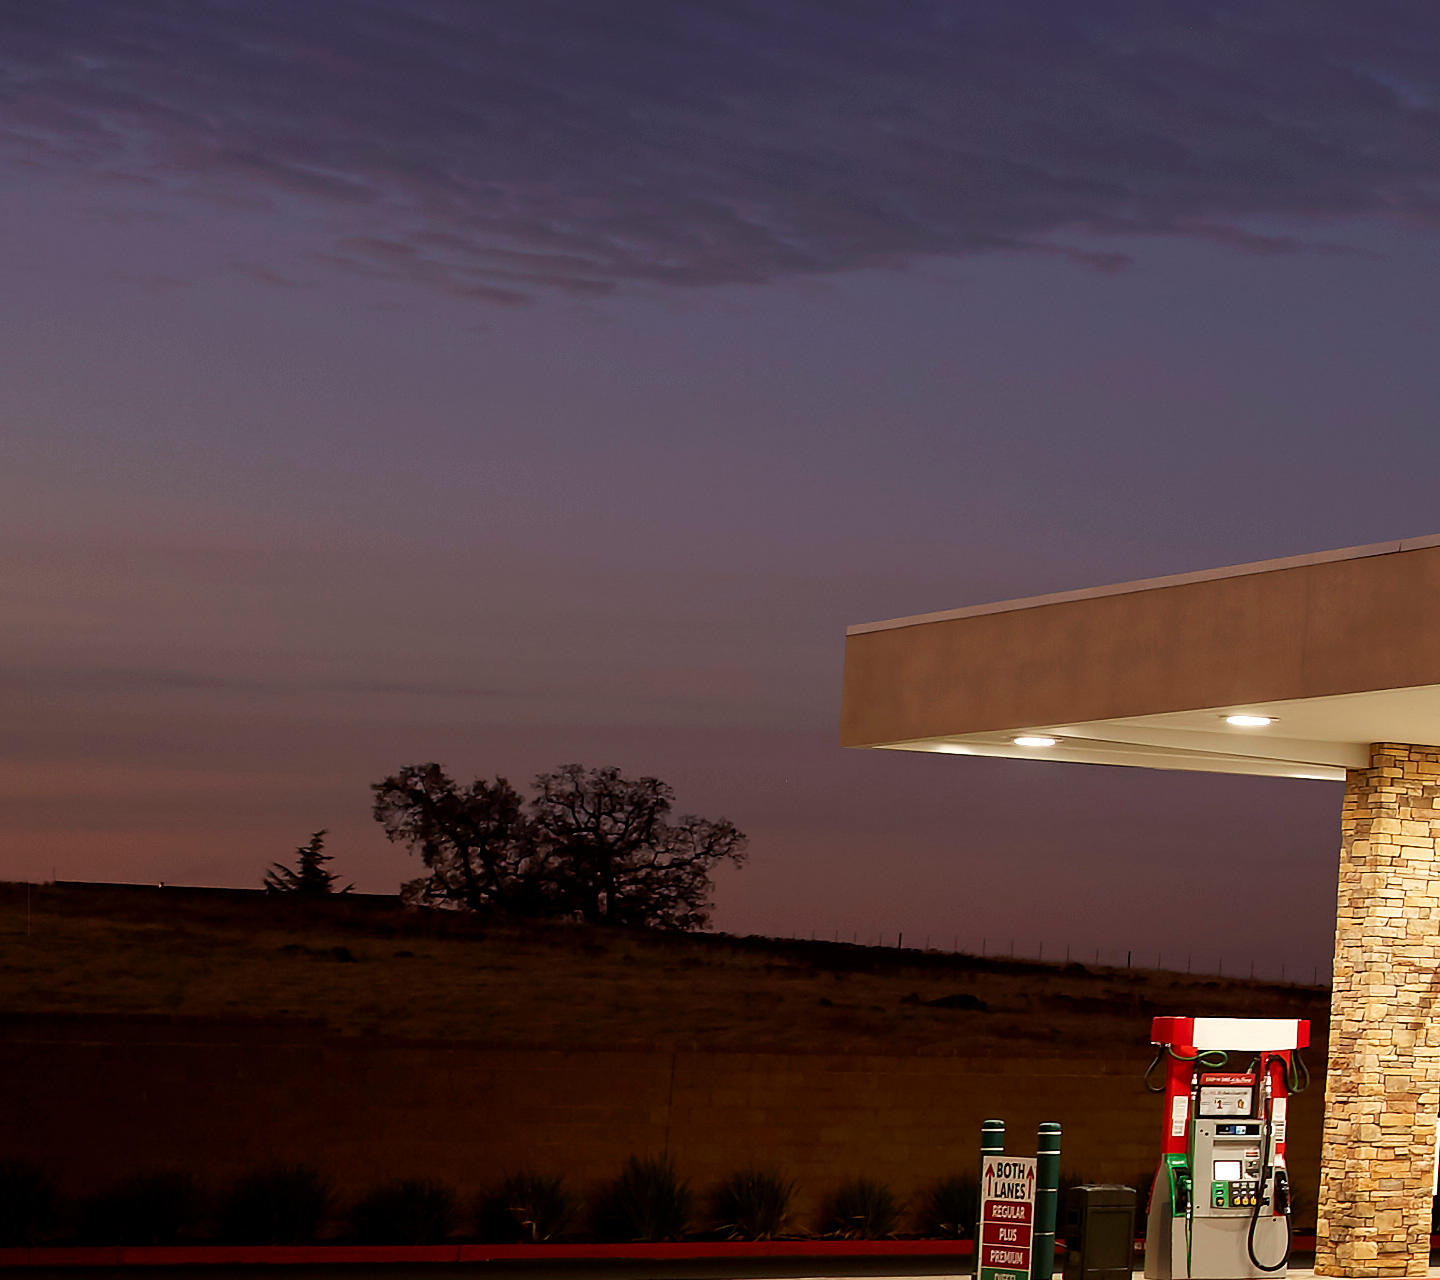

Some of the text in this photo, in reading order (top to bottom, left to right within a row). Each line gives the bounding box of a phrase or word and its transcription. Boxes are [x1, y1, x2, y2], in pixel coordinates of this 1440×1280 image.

[997, 1162, 1025, 1179] BOTH
[994, 1182, 1026, 1199] LANES
[992, 1205, 1025, 1219] REGULAR
[999, 1228, 1017, 1241] PLUS
[990, 1250, 1023, 1264] PREMIUM
